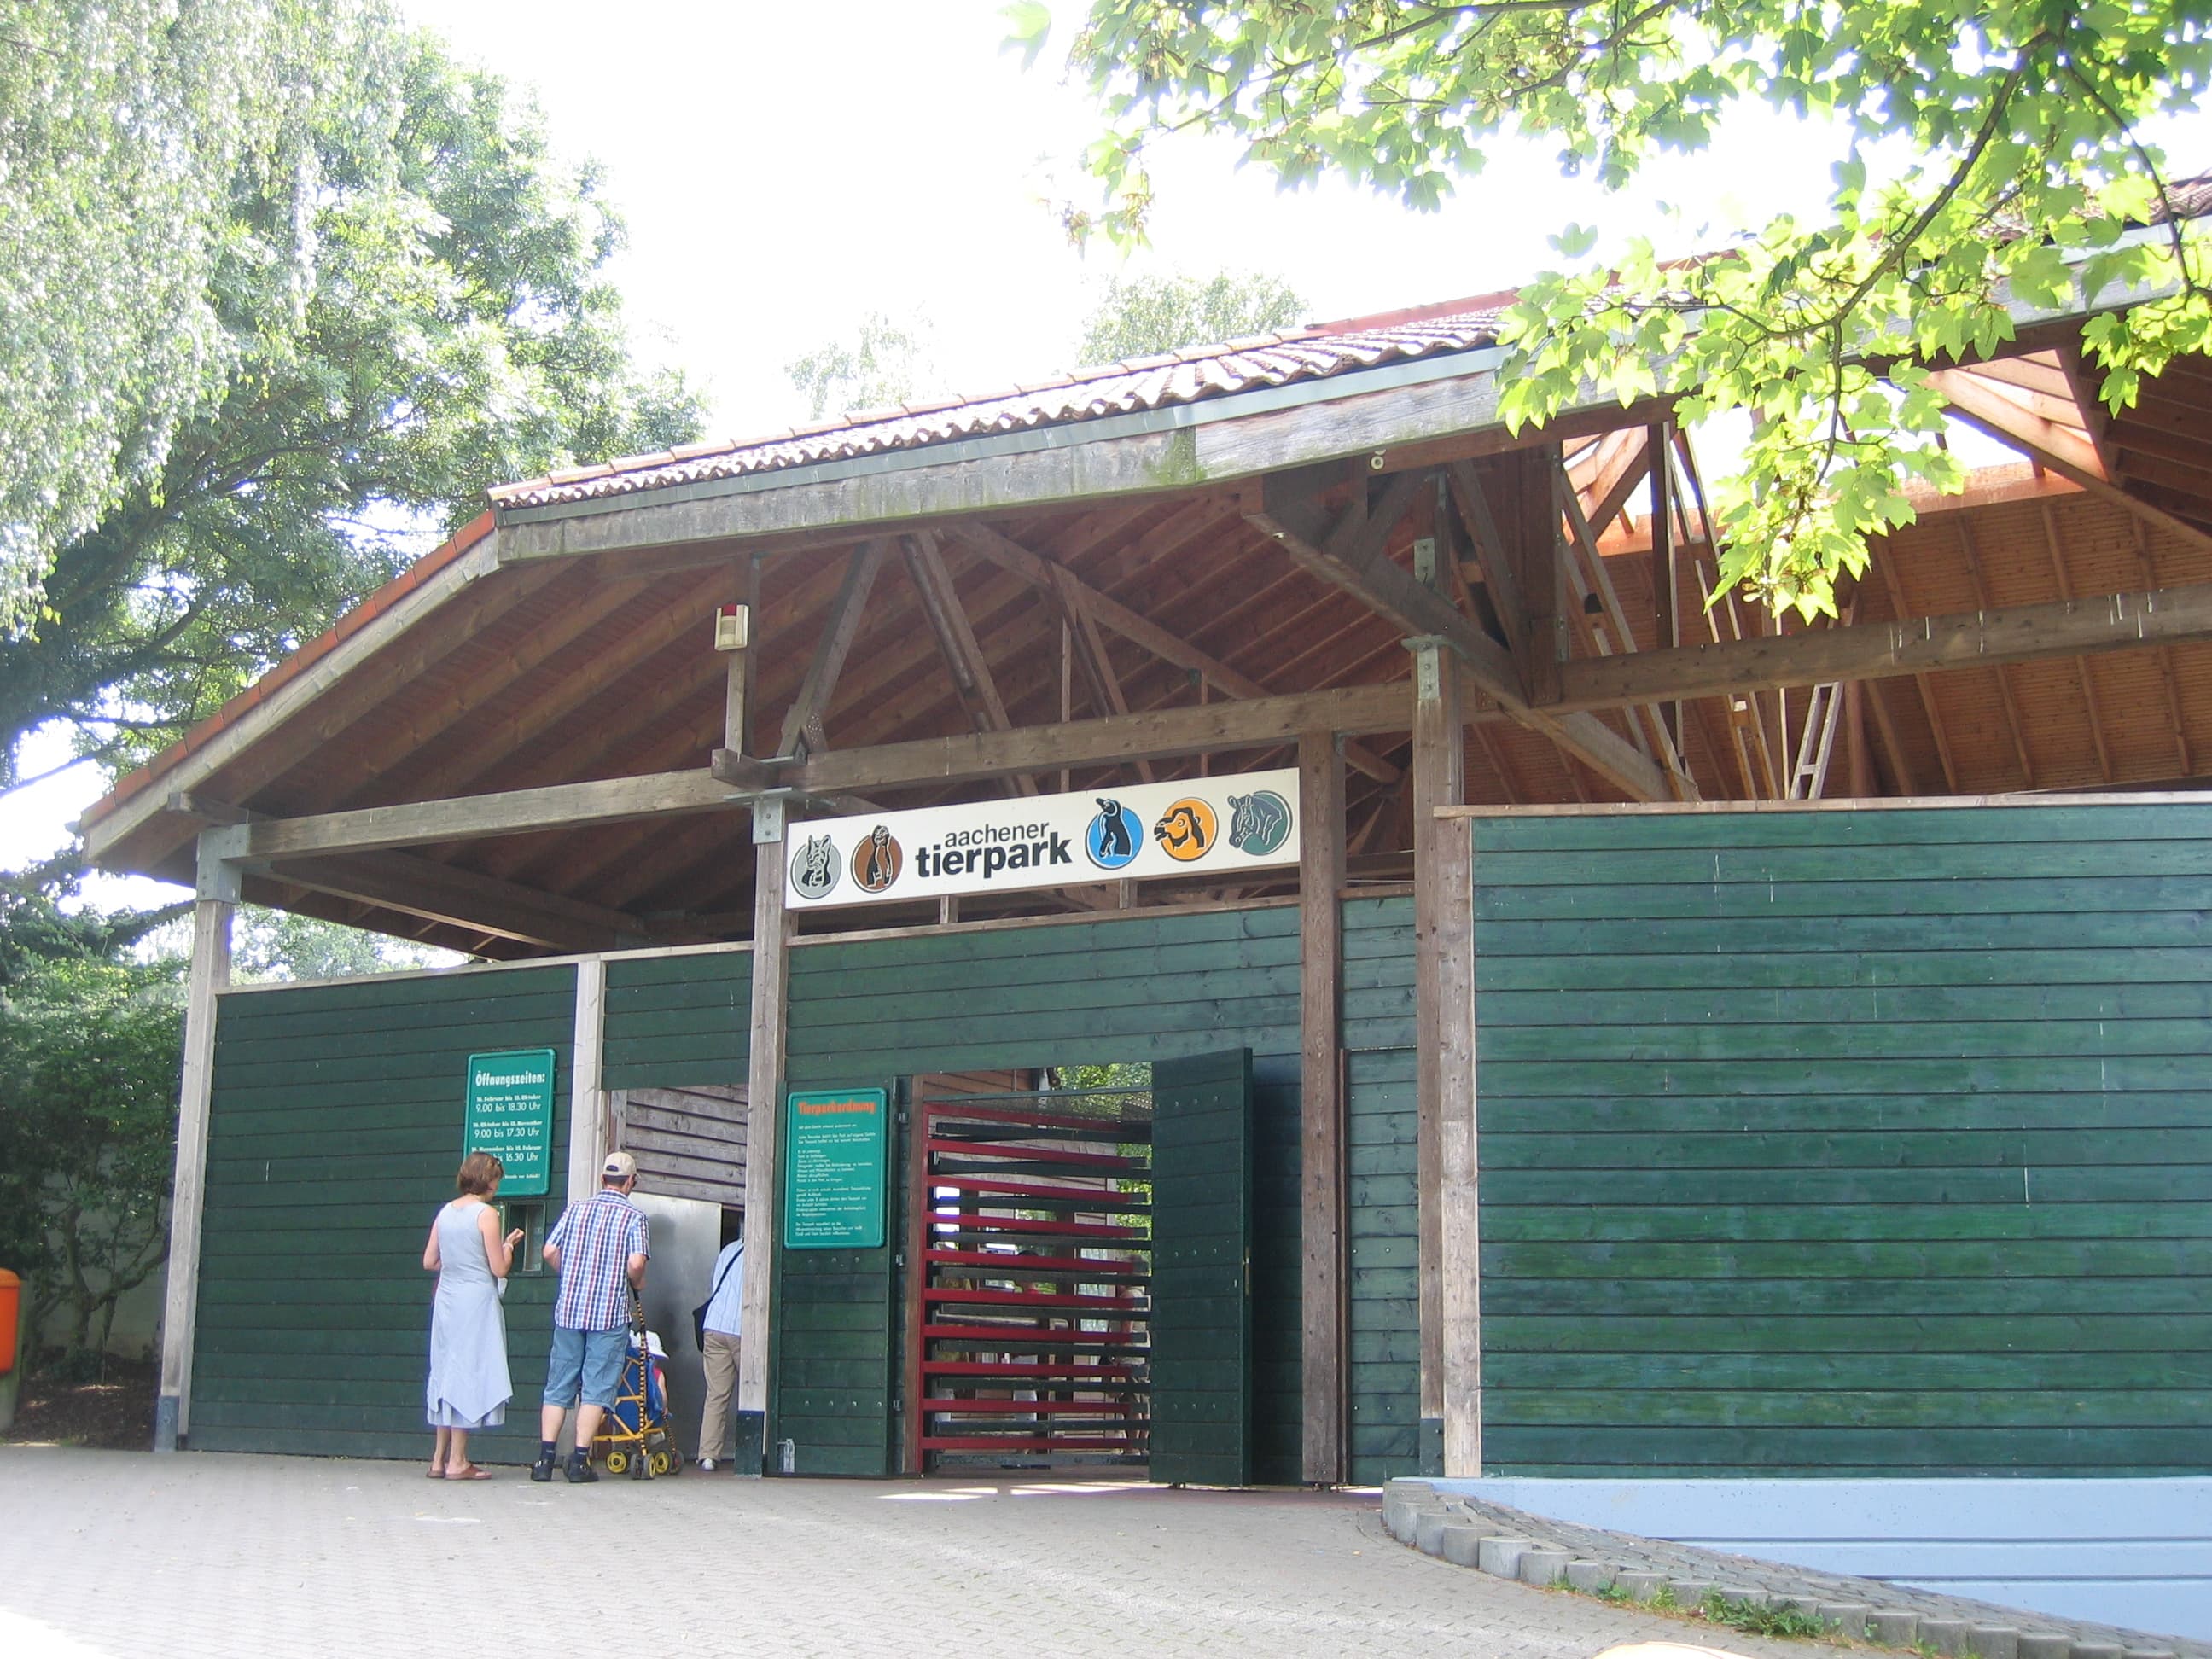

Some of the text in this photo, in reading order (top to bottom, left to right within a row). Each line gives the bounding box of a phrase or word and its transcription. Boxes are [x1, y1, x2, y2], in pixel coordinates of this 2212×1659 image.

[945, 822, 1049, 847] aachener
[915, 832, 1072, 878] tierpark
[475, 1070, 545, 1087] Öffnungszeiten:
[476, 1101, 541, 1113] 9.00 bis 18.30 Uhr
[474, 1126, 539, 1138] 9.00 bis 17.30 Uhr
[505, 1152, 525, 1162] 16.30
[527, 1151, 538, 1161] Uhr
